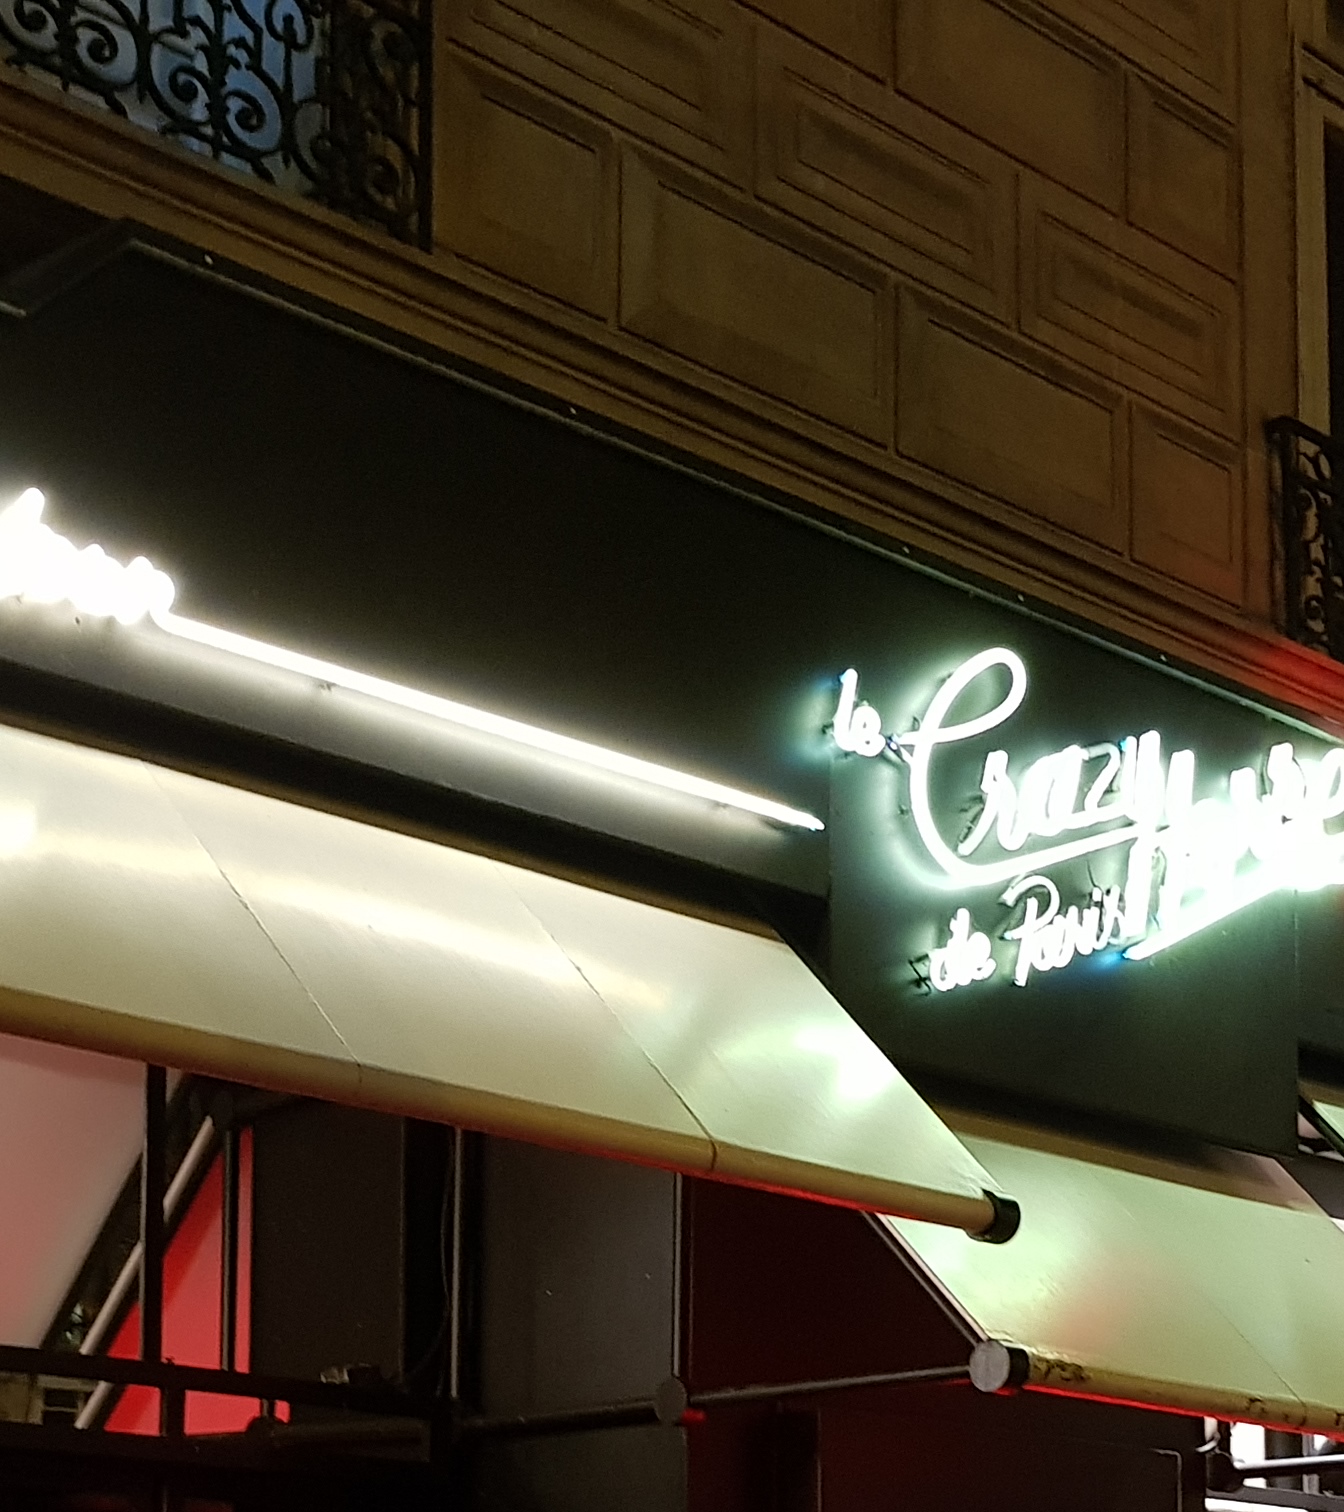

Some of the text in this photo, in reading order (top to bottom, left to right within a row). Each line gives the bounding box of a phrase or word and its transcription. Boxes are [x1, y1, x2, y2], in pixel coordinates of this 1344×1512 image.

[896, 646, 1160, 935] Crazy
[928, 872, 1122, 992] de Paris
